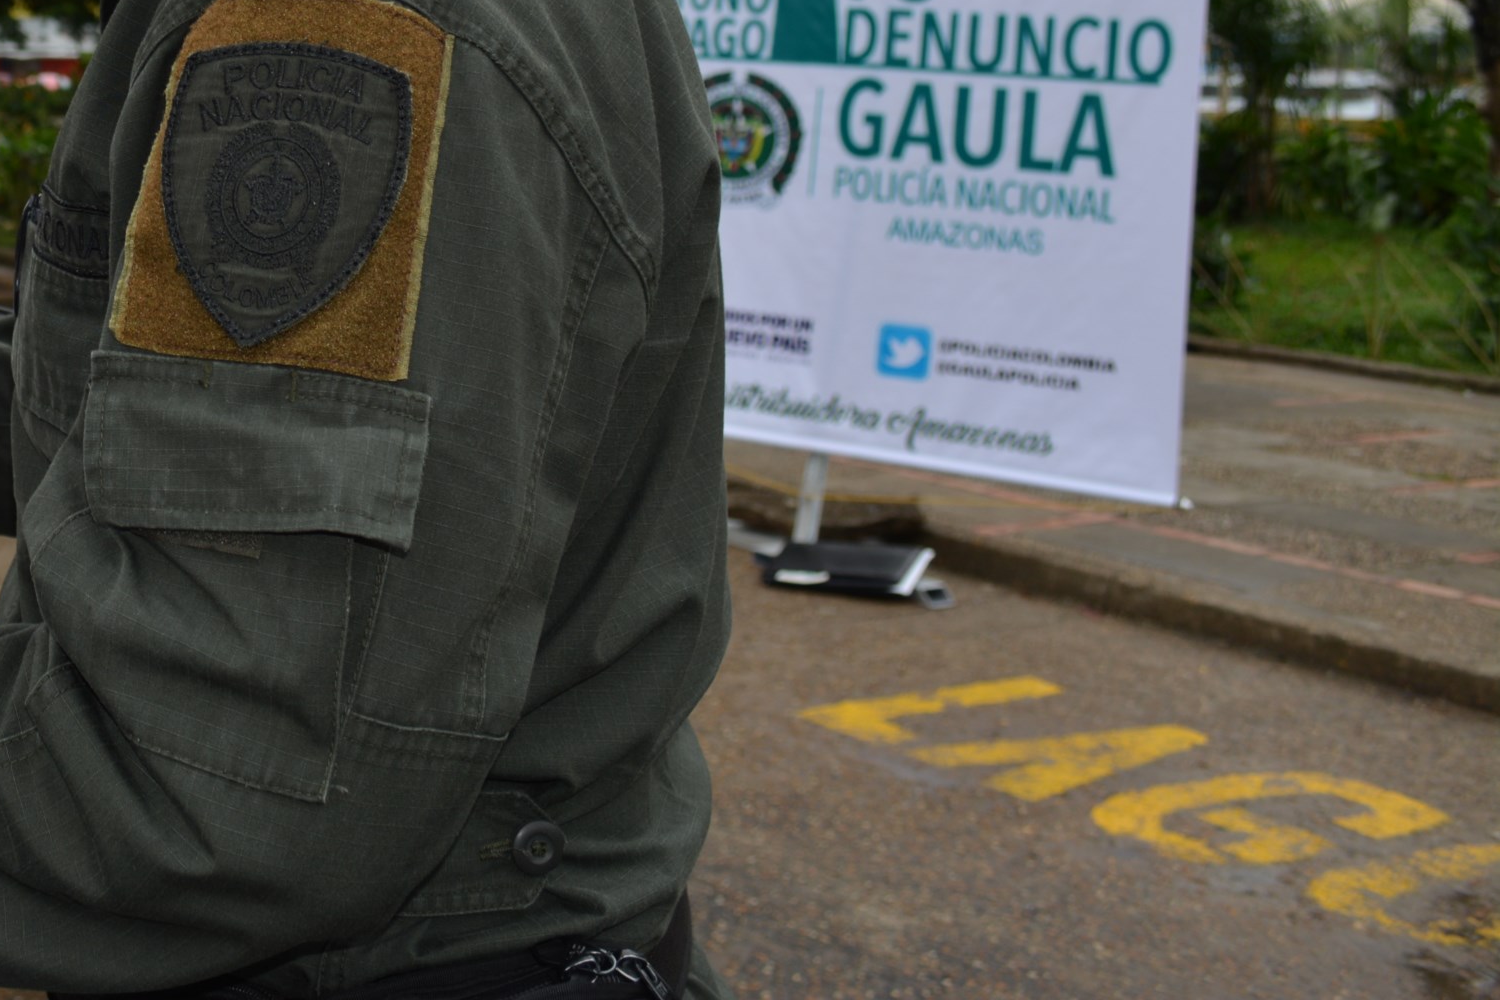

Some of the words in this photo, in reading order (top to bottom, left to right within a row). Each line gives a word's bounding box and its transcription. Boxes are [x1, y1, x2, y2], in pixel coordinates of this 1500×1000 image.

[684, 17, 766, 59] AGO
[844, 8, 1174, 84] DENUNCIO
[223, 58, 366, 104] POLICIA
[198, 91, 372, 146] NACIONAL
[837, 77, 1116, 179] GAULA
[831, 164, 949, 209] POLICÍA
[953, 176, 1116, 225] NACIONAL
[885, 215, 1046, 257] AMAZONAS
